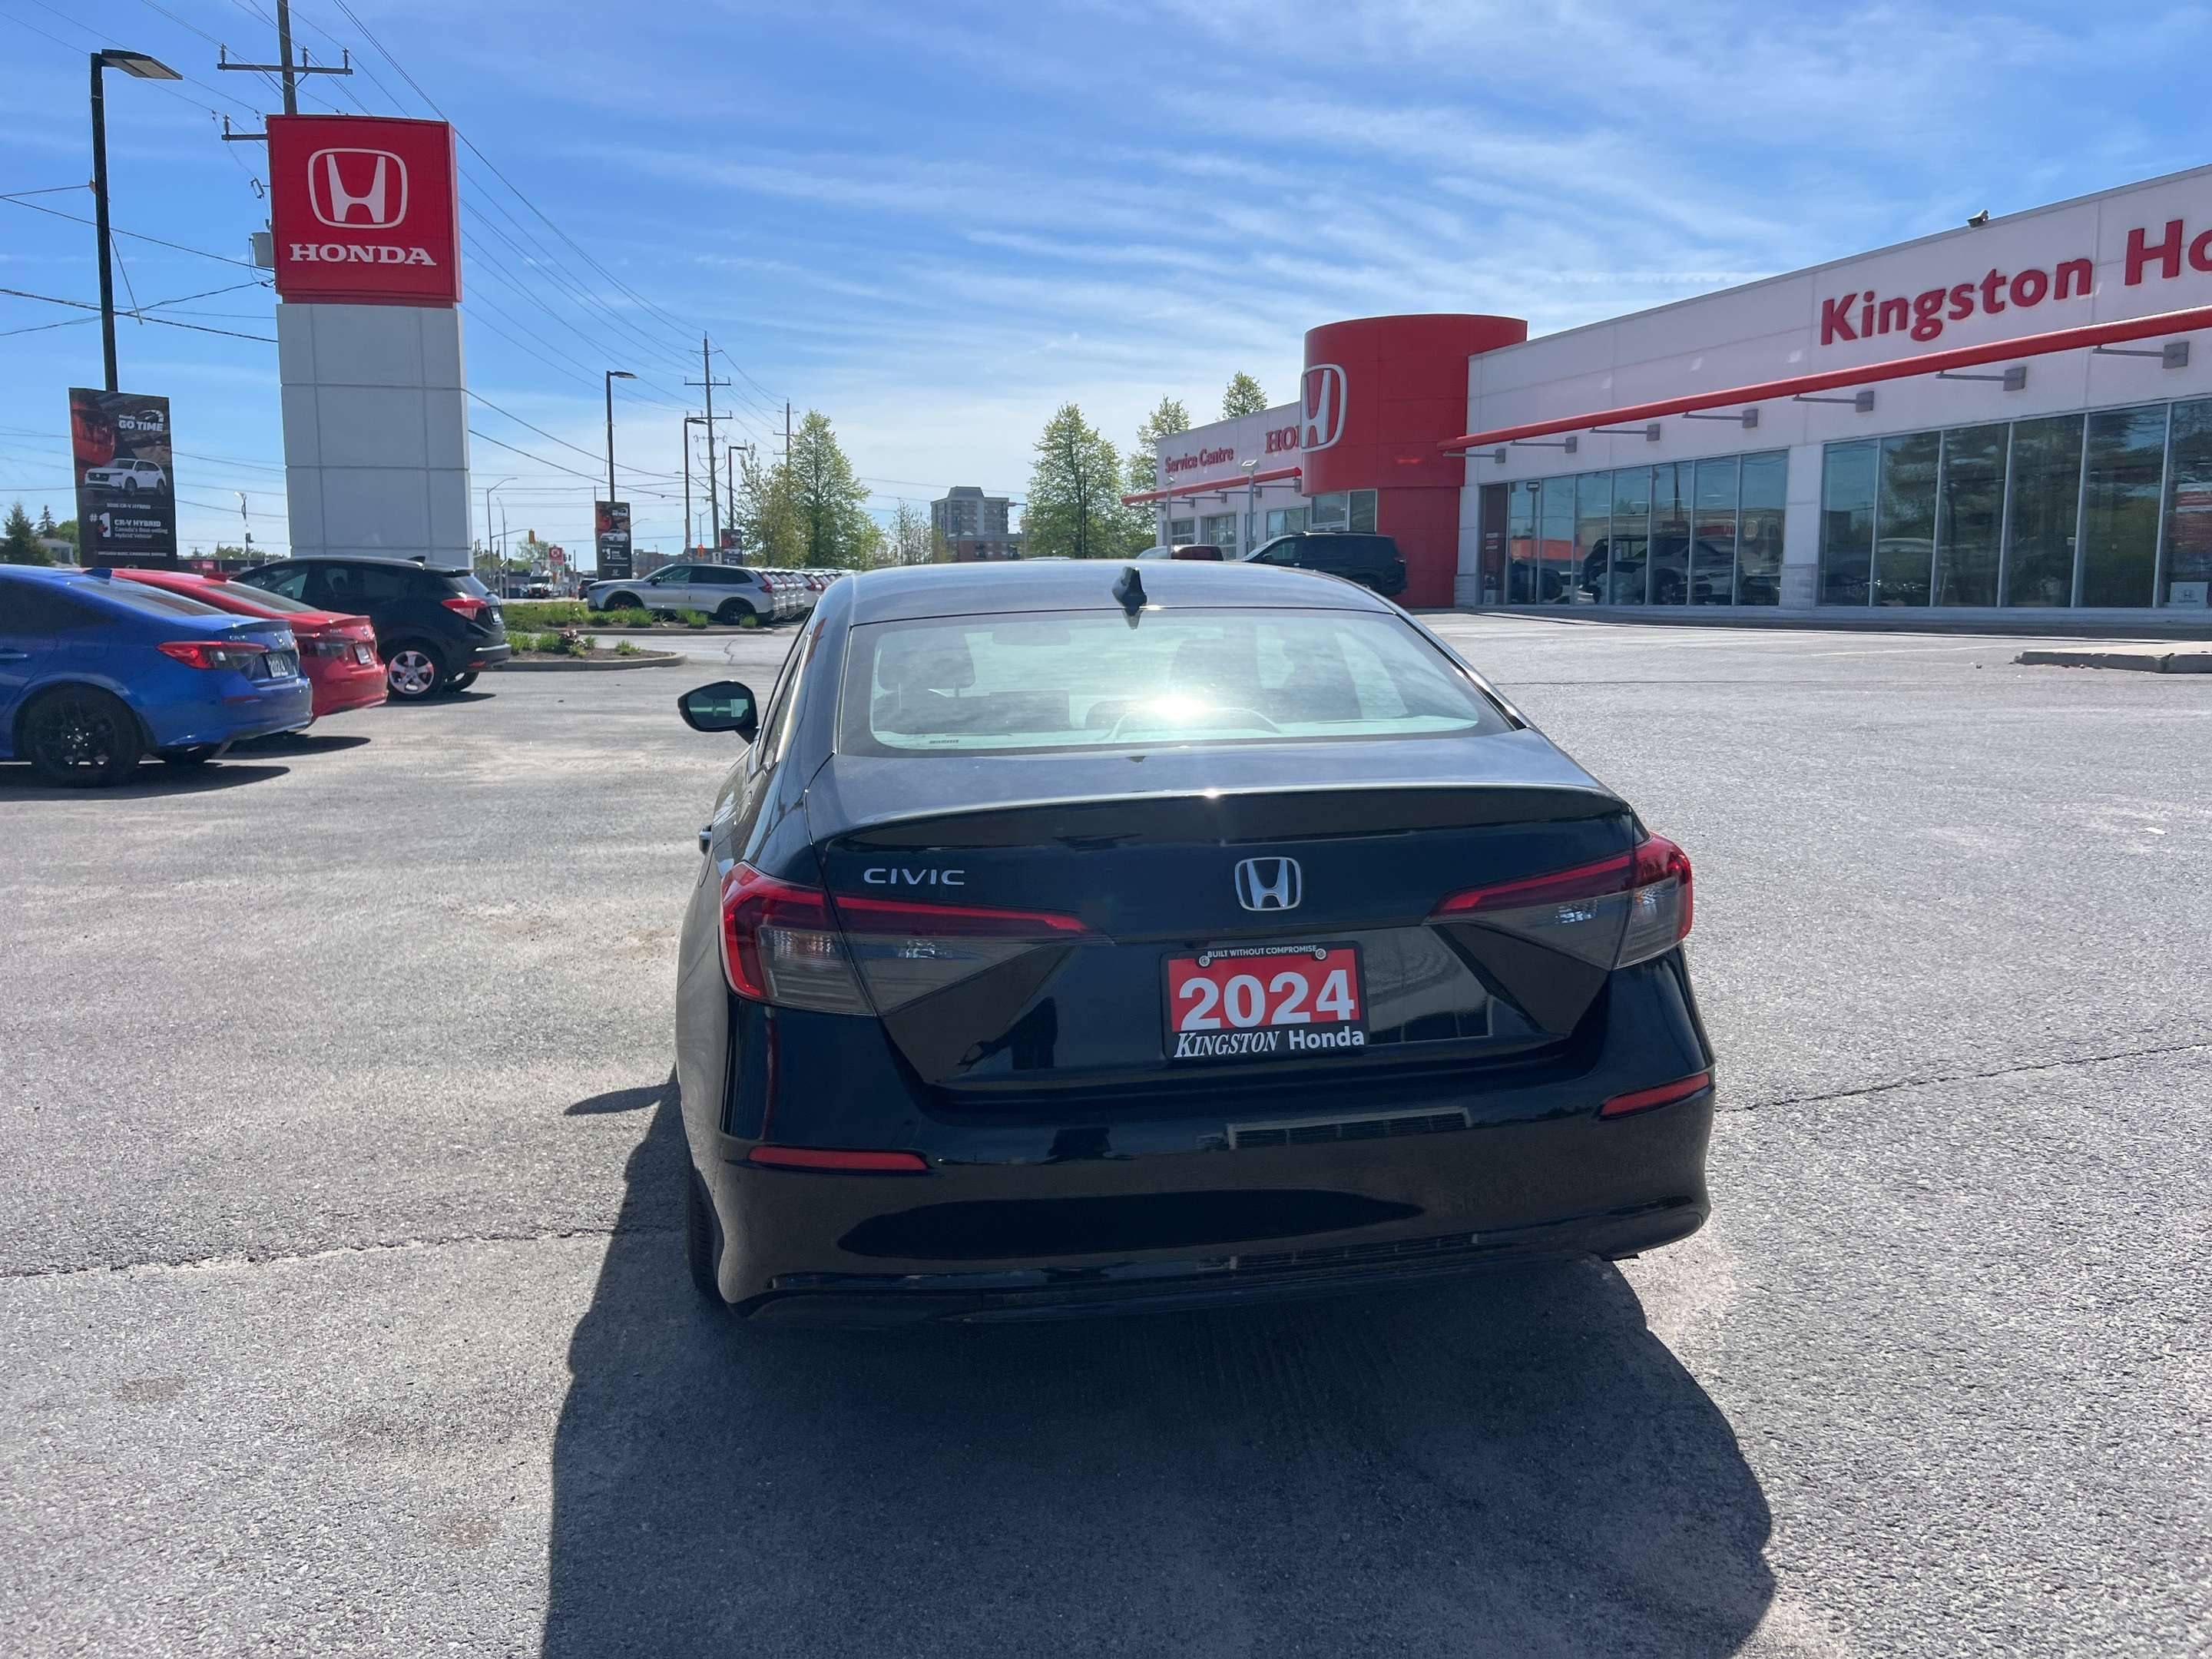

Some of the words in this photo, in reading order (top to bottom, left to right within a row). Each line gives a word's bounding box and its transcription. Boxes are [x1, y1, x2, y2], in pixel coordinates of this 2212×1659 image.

[289, 243, 437, 266] HONDA
[1820, 257, 2093, 346] Kingston
[118, 419, 135, 429] GO
[136, 421, 164, 432] TIME
[1264, 426, 1300, 455] HO
[1164, 452, 1197, 474] Service
[1199, 447, 1234, 467] Centre
[133, 519, 162, 528] HYBRID
[863, 868, 965, 886] CIVIC
[1207, 949, 1228, 959] BUILT
[1229, 948, 1264, 957] WITHOUT
[1266, 945, 1317, 955] COMPROMISE
[1179, 969, 1356, 1032] 2024
[1174, 1030, 1281, 1058] KINGSTON
[1288, 1025, 1366, 1050] Honda
